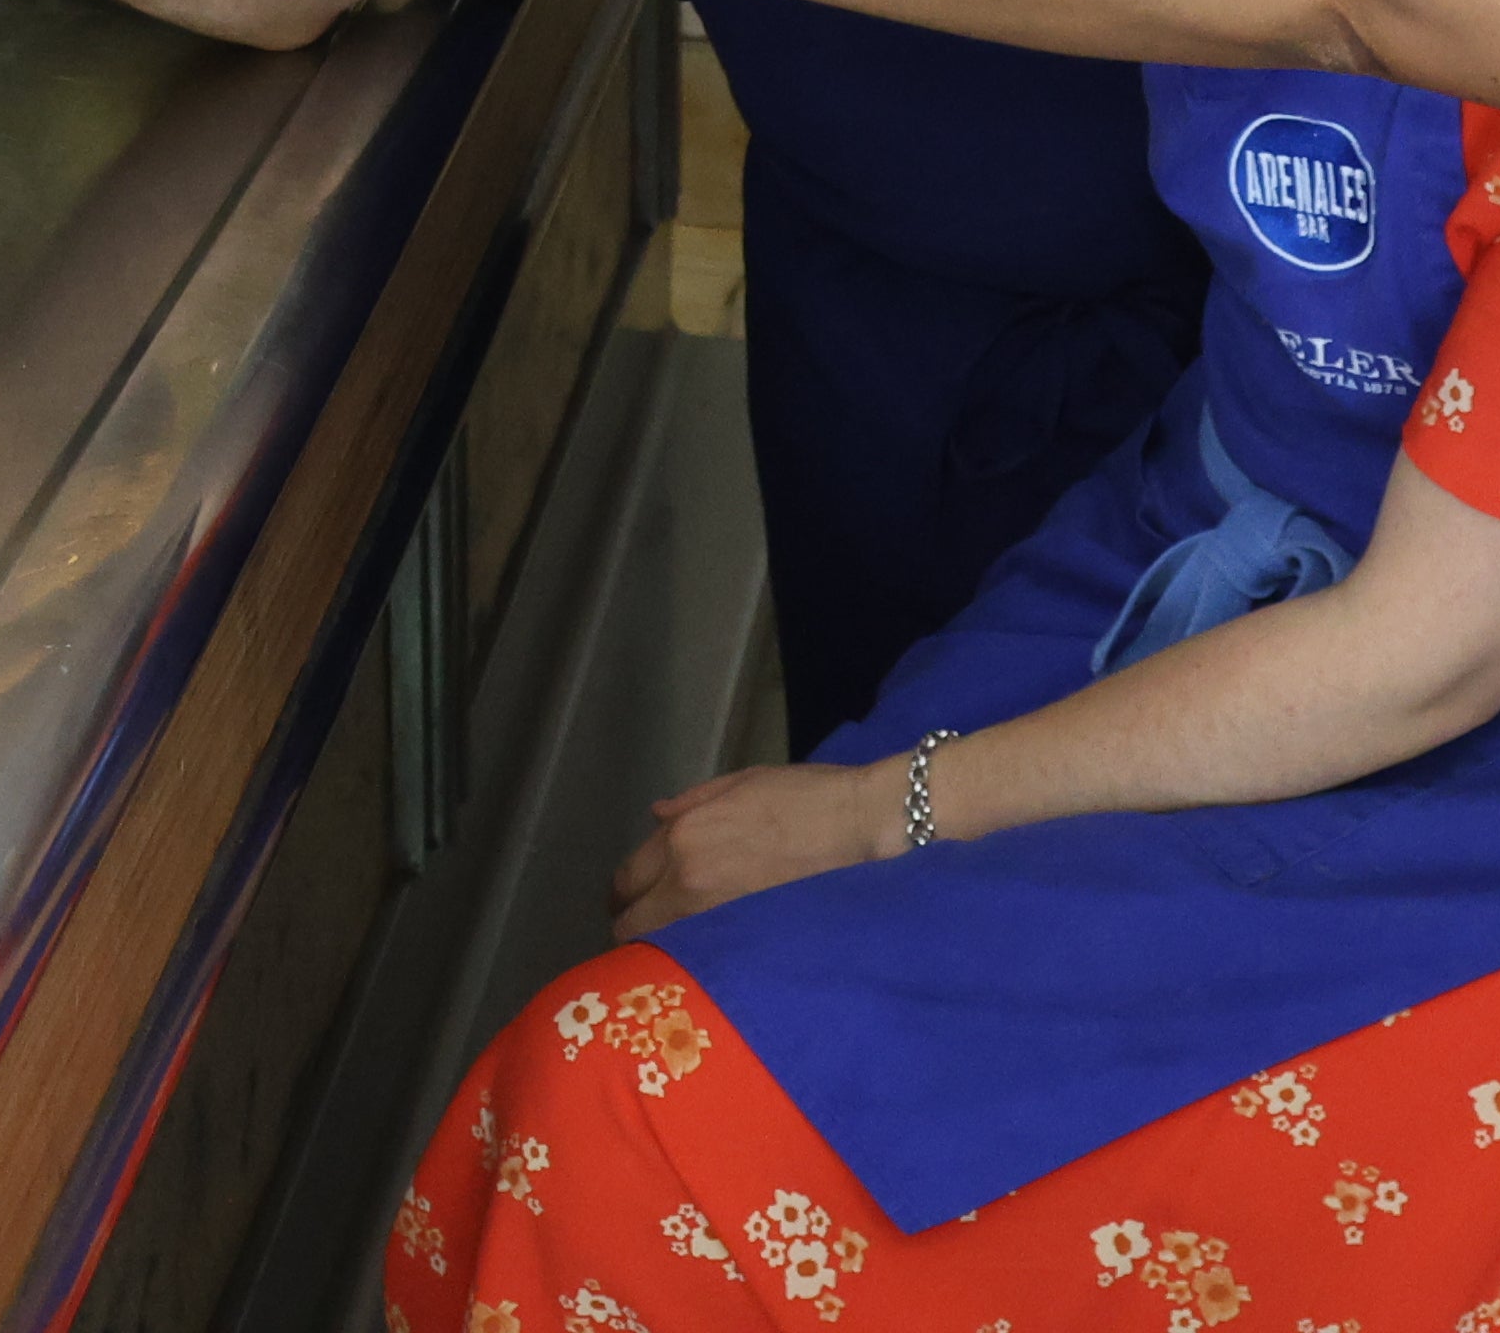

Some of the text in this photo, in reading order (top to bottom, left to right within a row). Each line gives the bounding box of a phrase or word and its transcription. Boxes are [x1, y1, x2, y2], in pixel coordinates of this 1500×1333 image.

[1243, 149, 1370, 225] ARENALES
[1296, 212, 1332, 245] BAR
[1275, 327, 1423, 389] ELER
